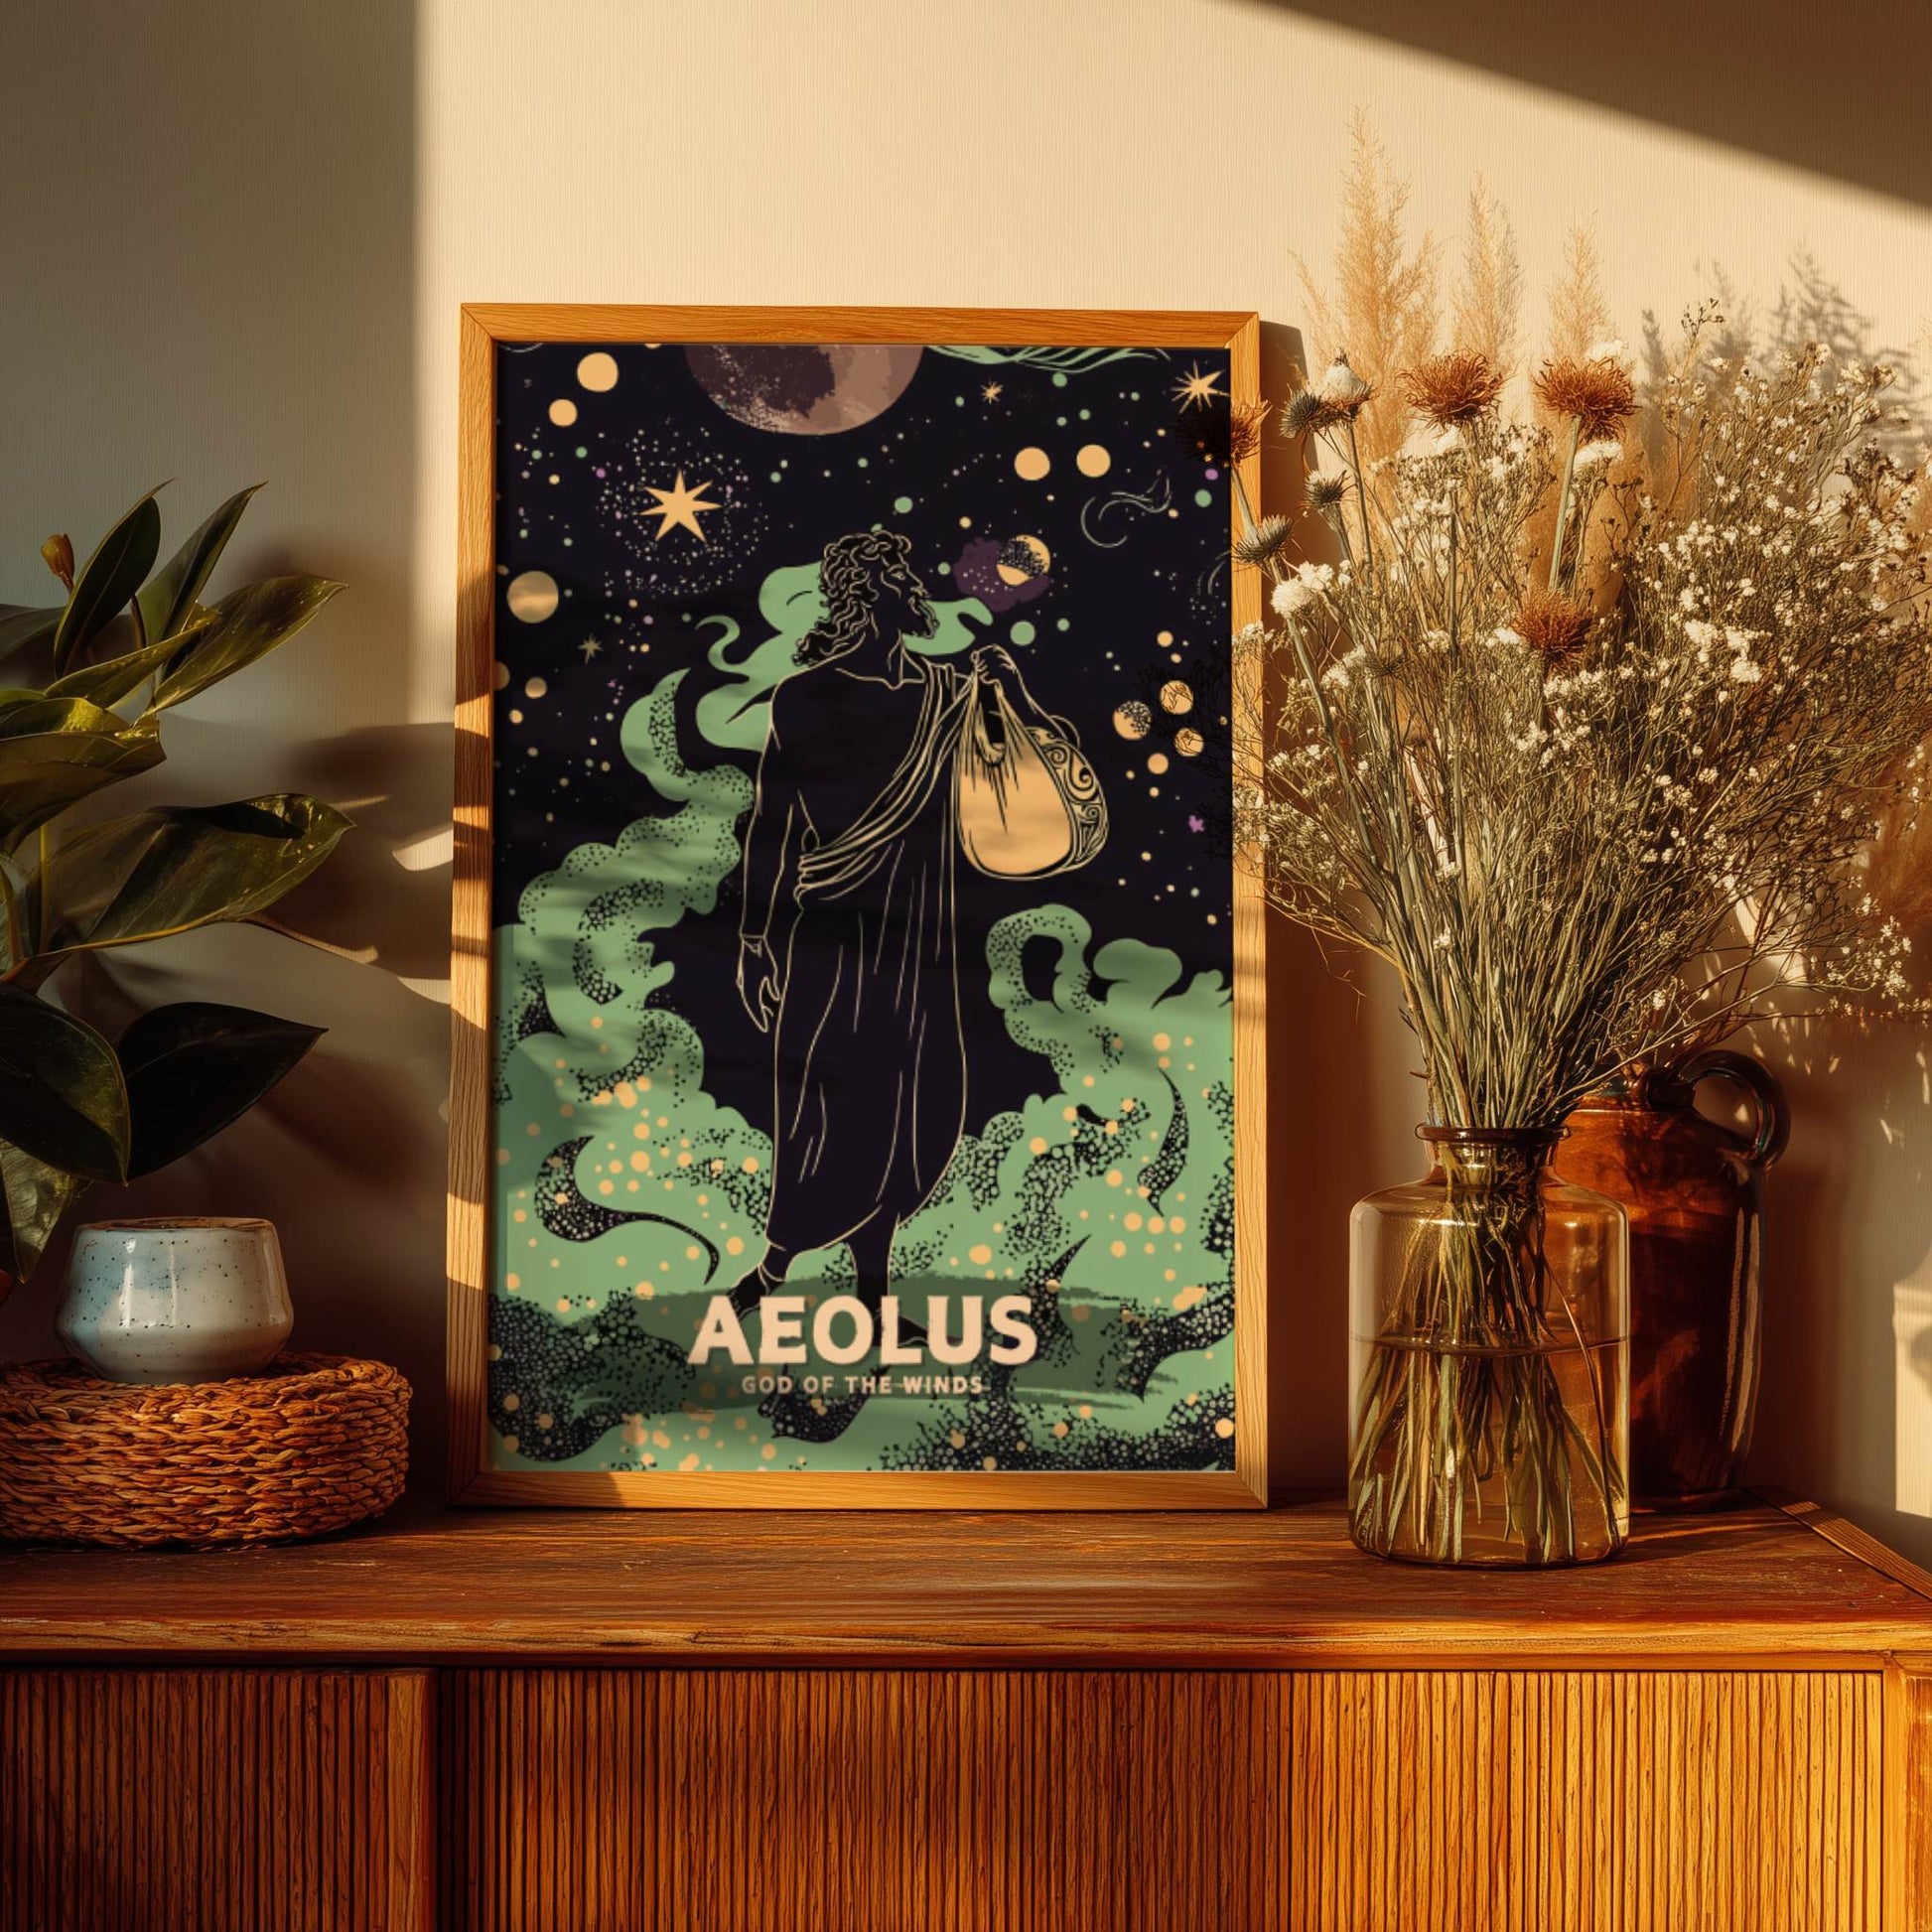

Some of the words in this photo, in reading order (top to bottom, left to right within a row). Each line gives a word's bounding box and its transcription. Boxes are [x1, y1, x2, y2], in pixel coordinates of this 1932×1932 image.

[687, 1295, 1037, 1365] AEOLUS
[742, 1375, 792, 1395] GOD
[803, 1375, 834, 1395] OF
[845, 1375, 892, 1395] THE
[903, 1375, 983, 1395] WINDS
